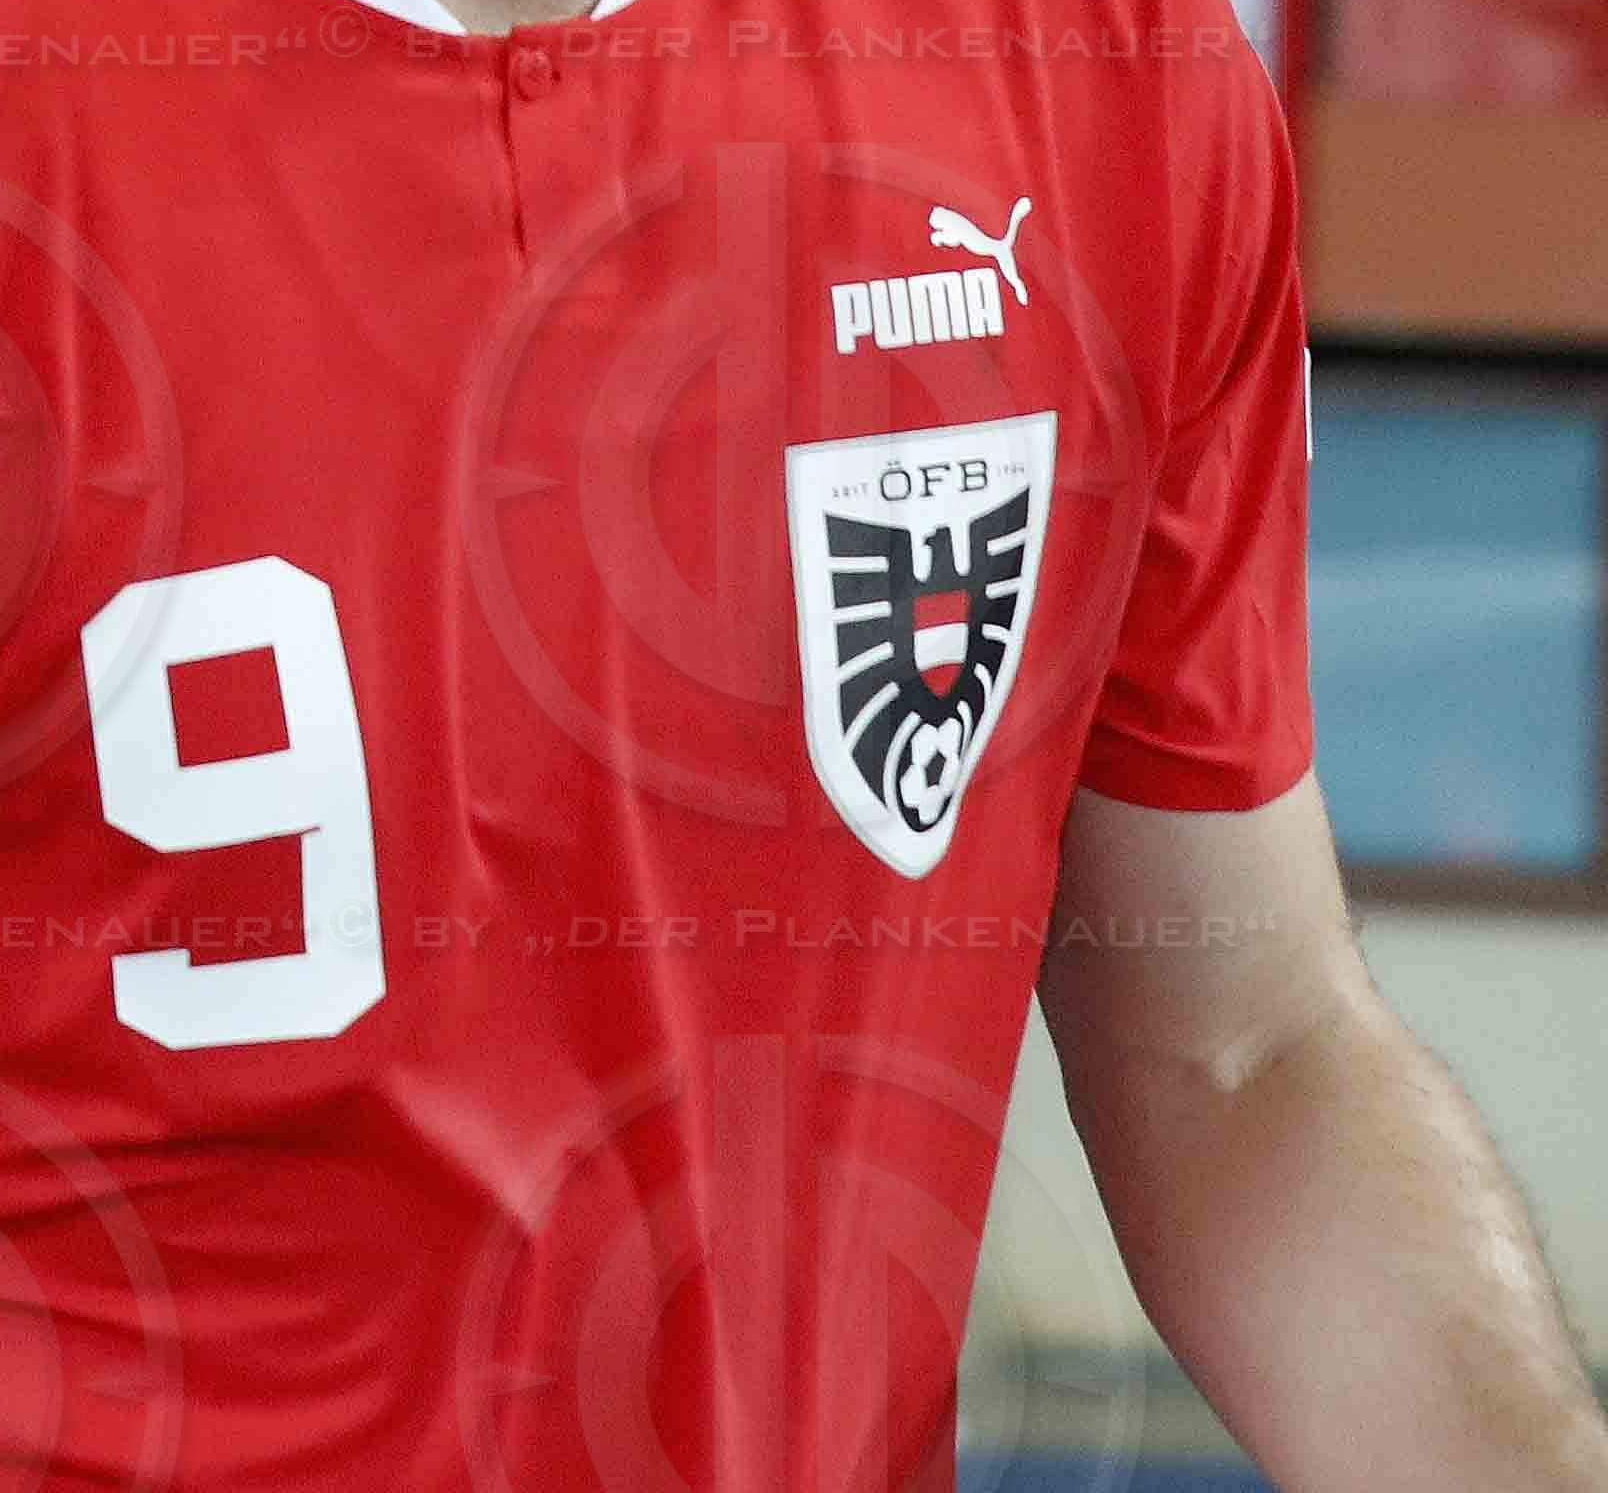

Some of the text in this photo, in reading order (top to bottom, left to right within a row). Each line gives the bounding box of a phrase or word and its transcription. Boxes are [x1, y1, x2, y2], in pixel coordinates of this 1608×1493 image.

[830, 267, 1006, 355] PUMA
[880, 459, 989, 501] ÖFB
[80, 554, 388, 1051] 9
